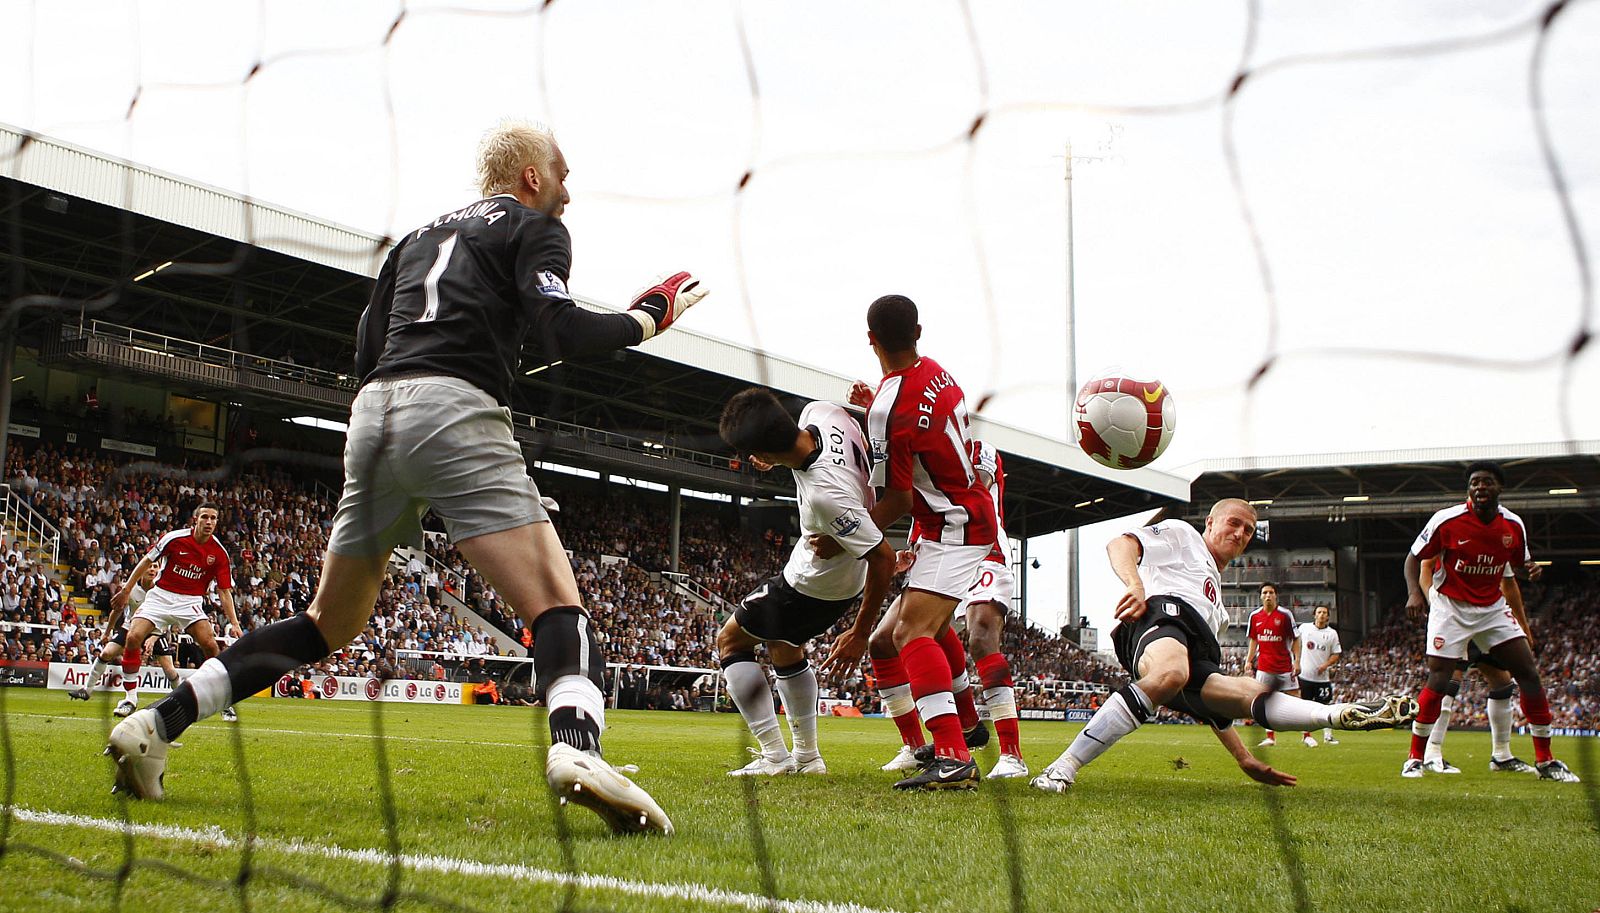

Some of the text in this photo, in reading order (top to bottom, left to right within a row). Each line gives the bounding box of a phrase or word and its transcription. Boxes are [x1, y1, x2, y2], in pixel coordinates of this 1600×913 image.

[415, 230, 458, 323] 1
[830, 425, 846, 466] SEOL
[1477, 554, 1494, 564] Fly
[341, 682, 358, 695] LG
[384, 684, 399, 697] LG
[419, 687, 432, 698] LG
[448, 688, 460, 698] LG
[1319, 688, 1330, 697] 25
